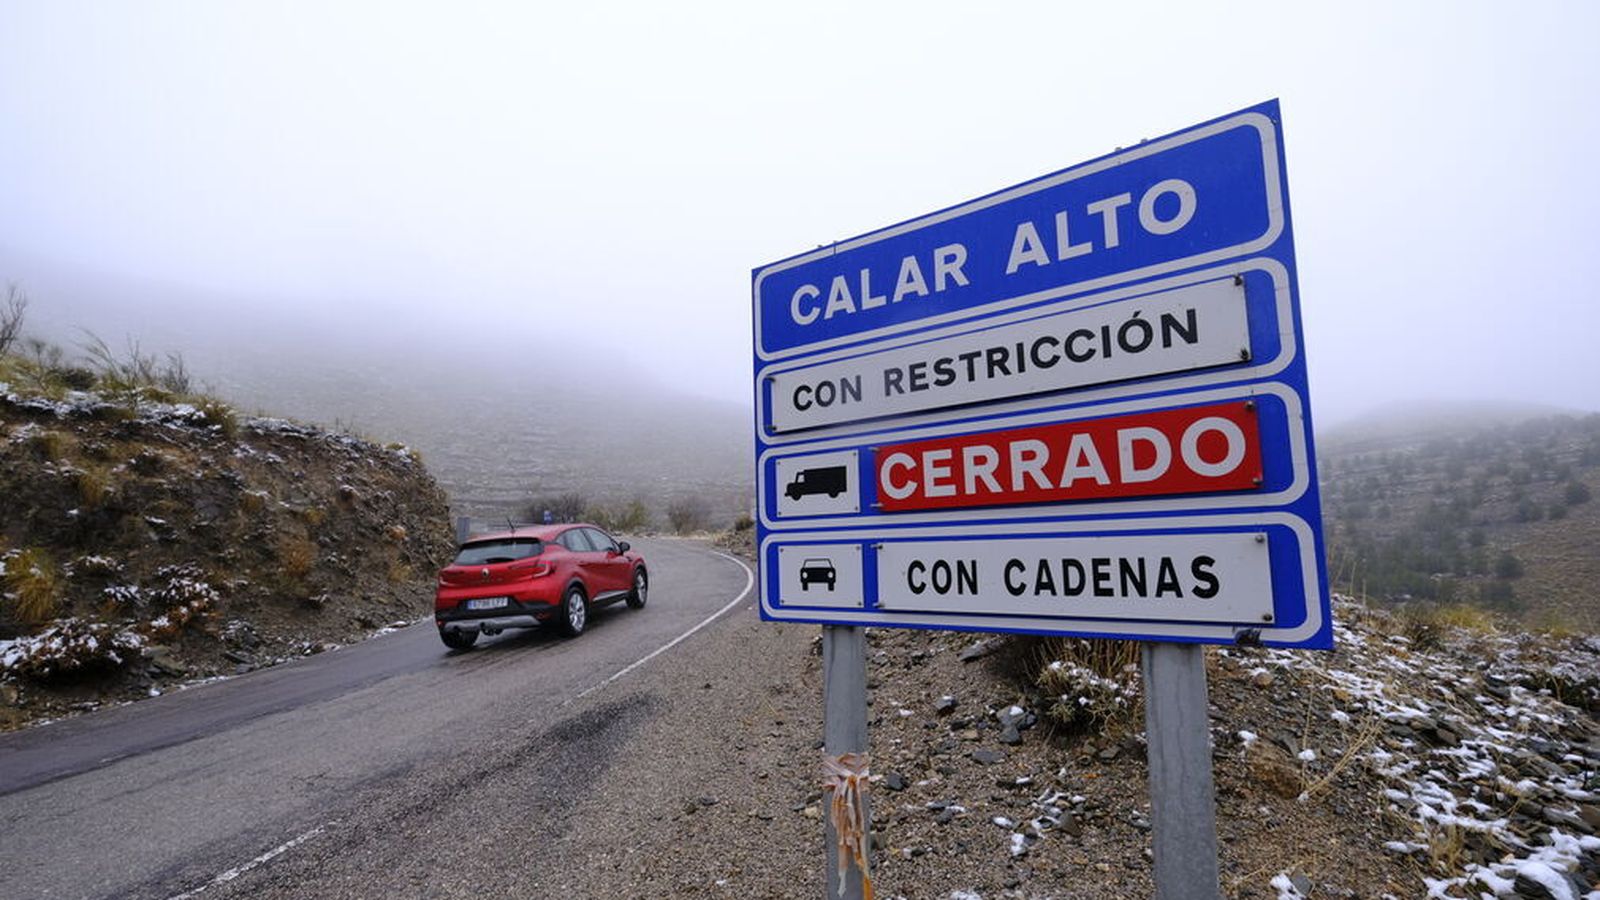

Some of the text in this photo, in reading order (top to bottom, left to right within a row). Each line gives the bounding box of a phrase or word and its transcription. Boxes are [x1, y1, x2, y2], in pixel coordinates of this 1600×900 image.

[790, 178, 1197, 325] CALAR ALTO
[792, 308, 1199, 411] CON RESTRICCIÓN
[880, 416, 1247, 499] CERRADO
[907, 555, 1221, 598] CON CADENAS
